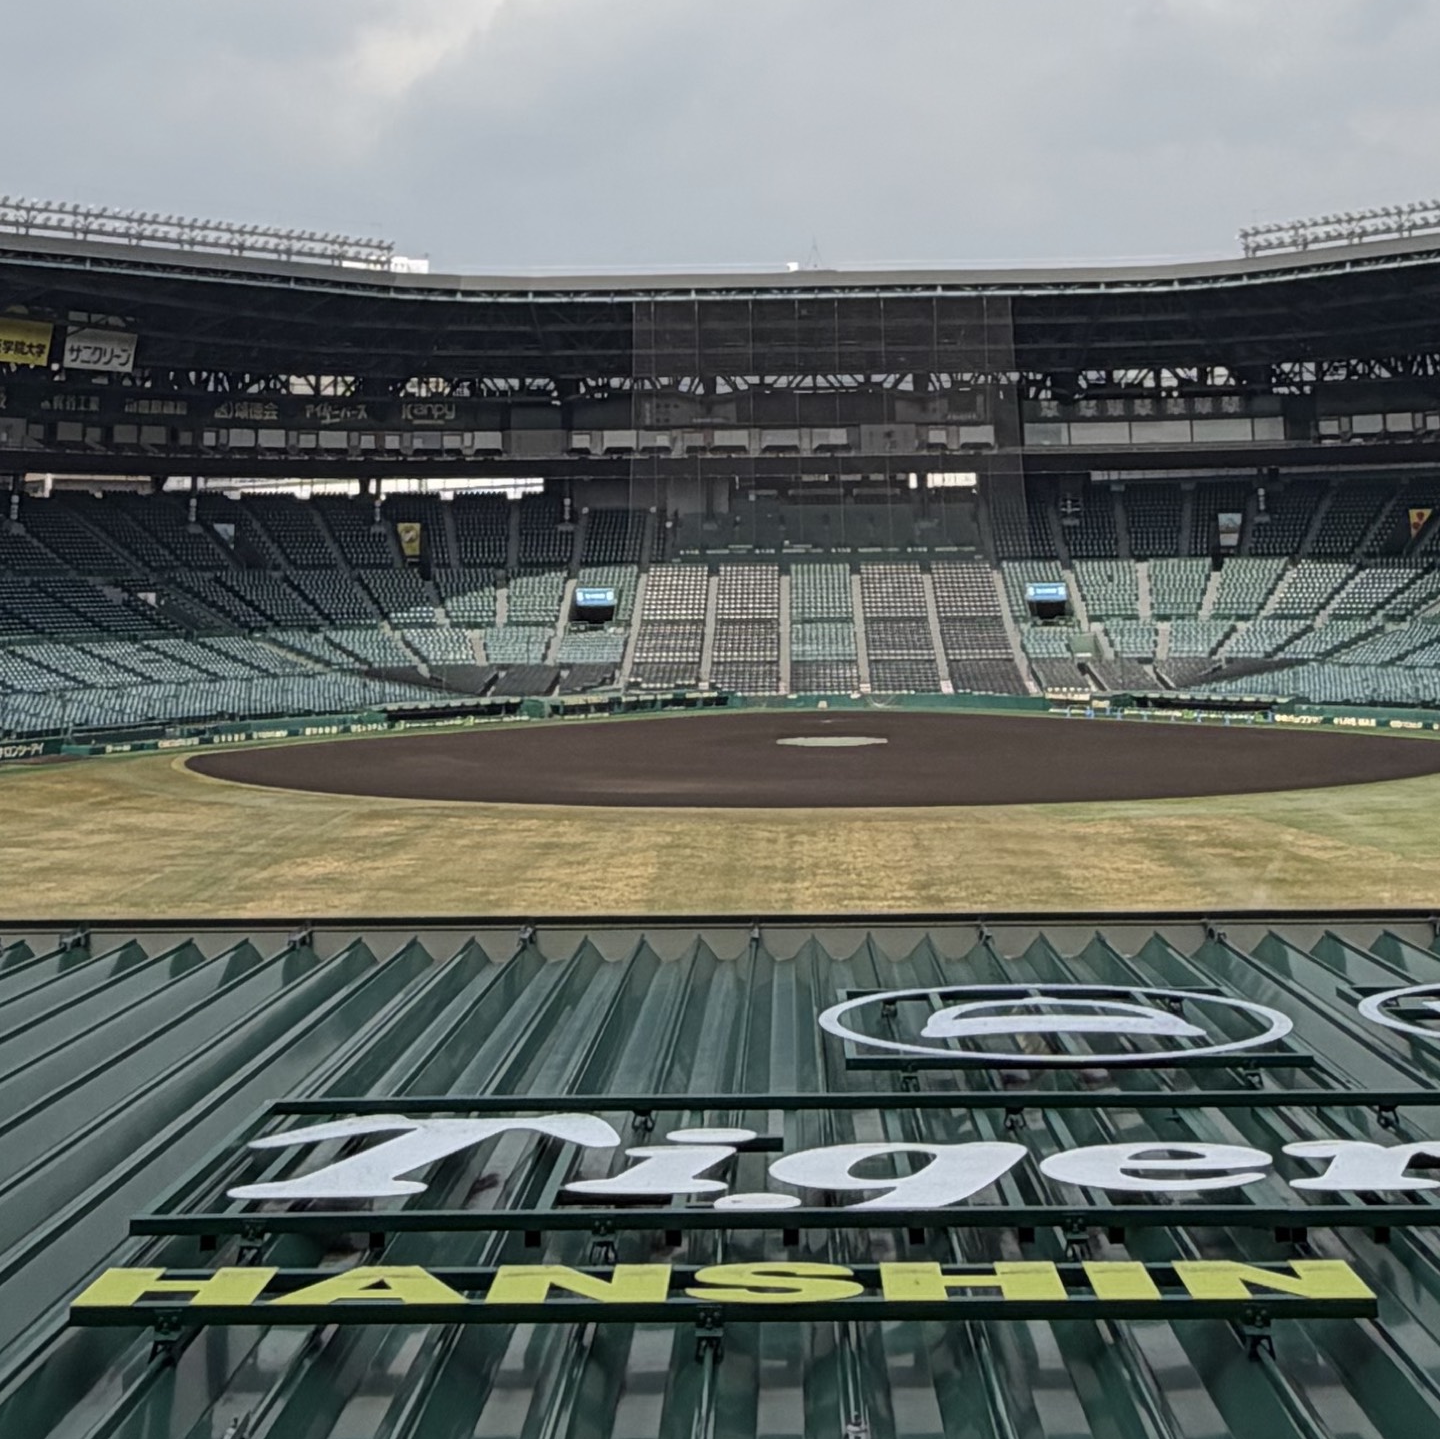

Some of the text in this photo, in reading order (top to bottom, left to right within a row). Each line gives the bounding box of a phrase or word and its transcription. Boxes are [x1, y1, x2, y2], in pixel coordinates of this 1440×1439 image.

[67, 344, 132, 367] サニクリーン
[70, 1259, 1376, 1305] HANSHIN
